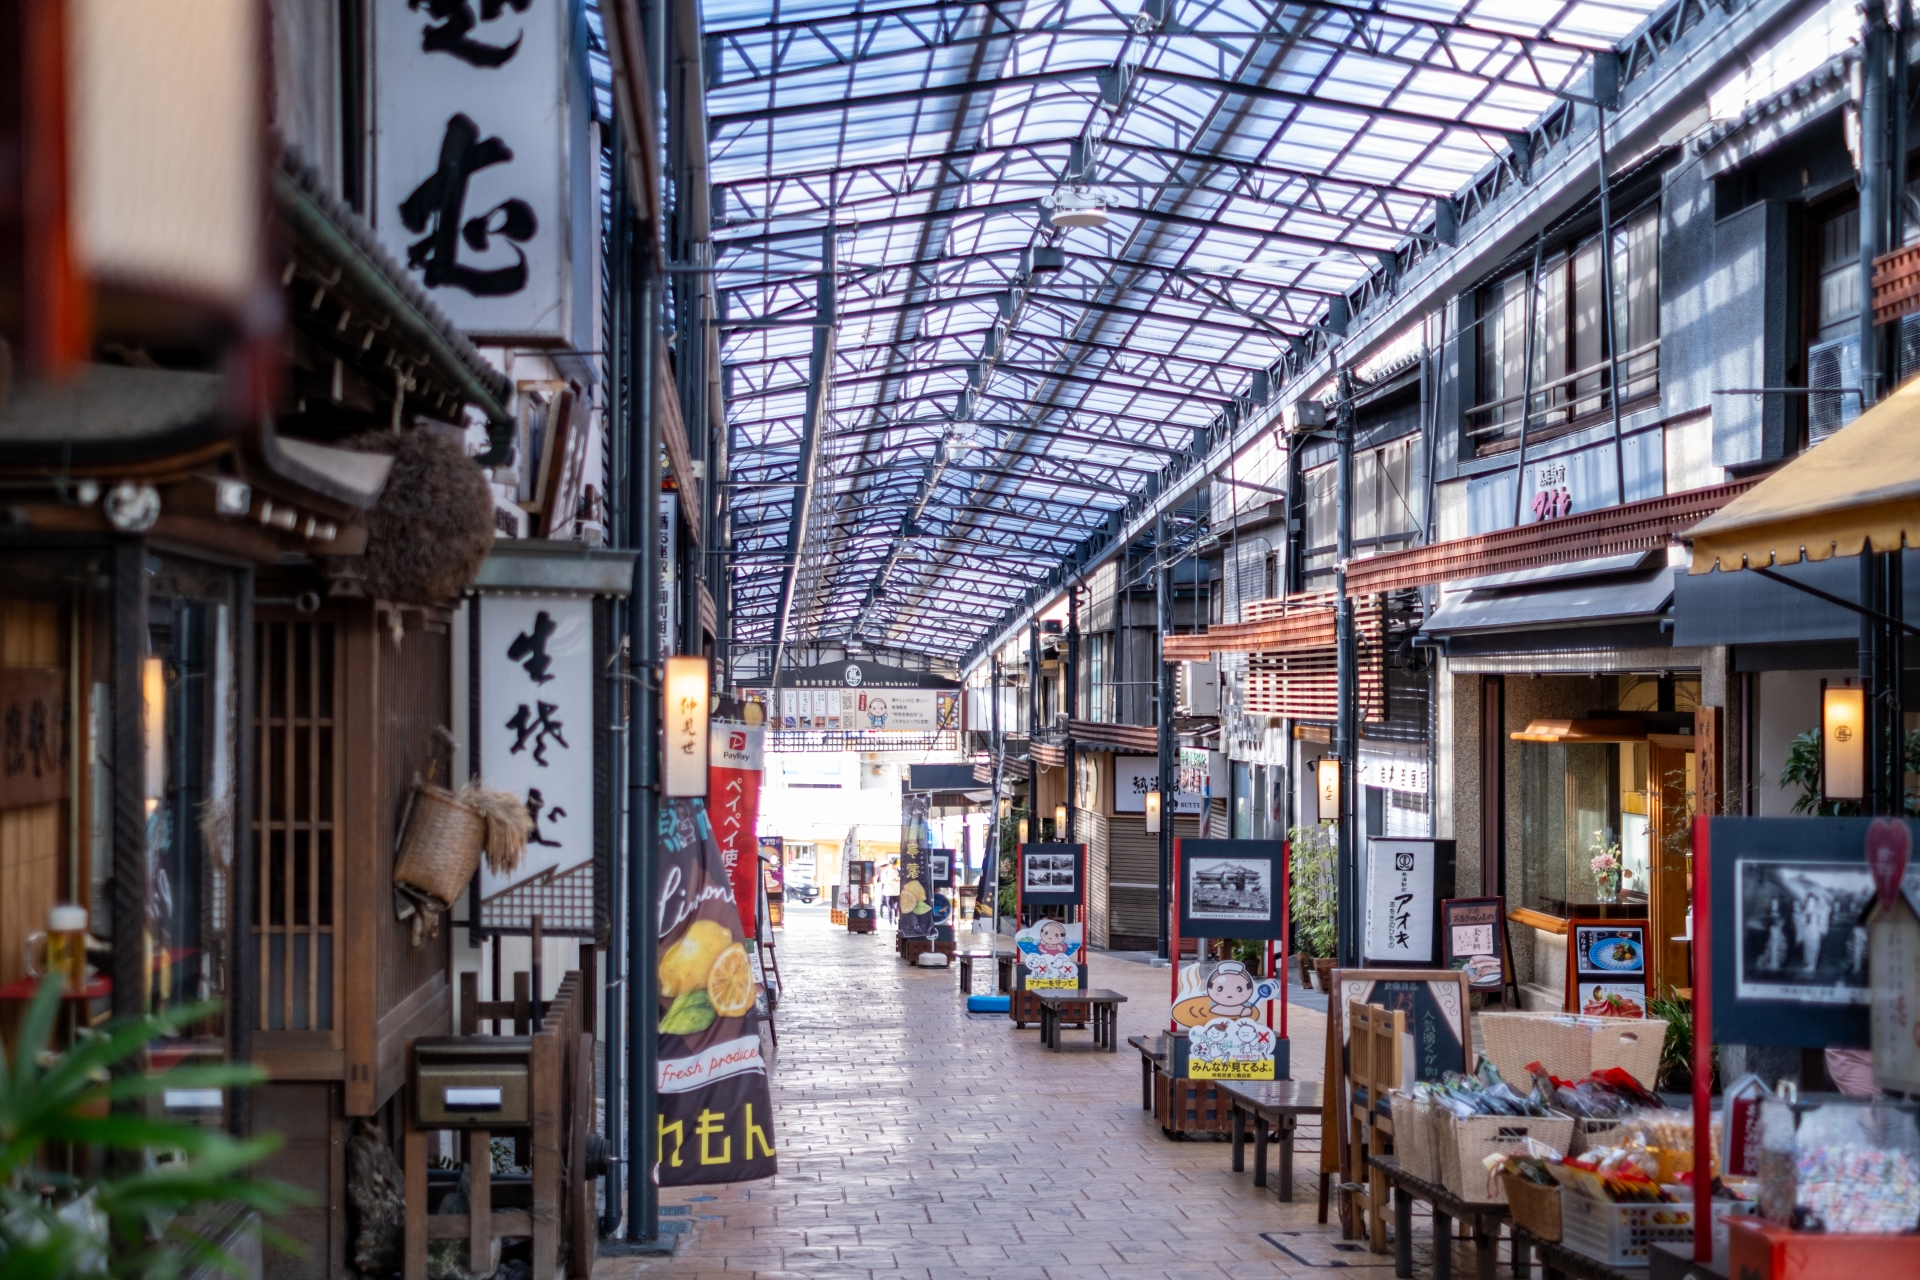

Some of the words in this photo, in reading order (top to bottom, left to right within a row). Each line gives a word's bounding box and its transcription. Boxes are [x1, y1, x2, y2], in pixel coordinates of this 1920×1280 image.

[680, 696, 697, 757] 仲見世
[723, 750, 751, 761] PayPay
[1394, 893, 1414, 949] アオキ
[1028, 979, 1076, 987] マナーを守って。
[658, 1061, 704, 1090] fresh
[708, 1047, 759, 1076] produce
[1191, 1061, 1273, 1072] みんなが見てるよ。
